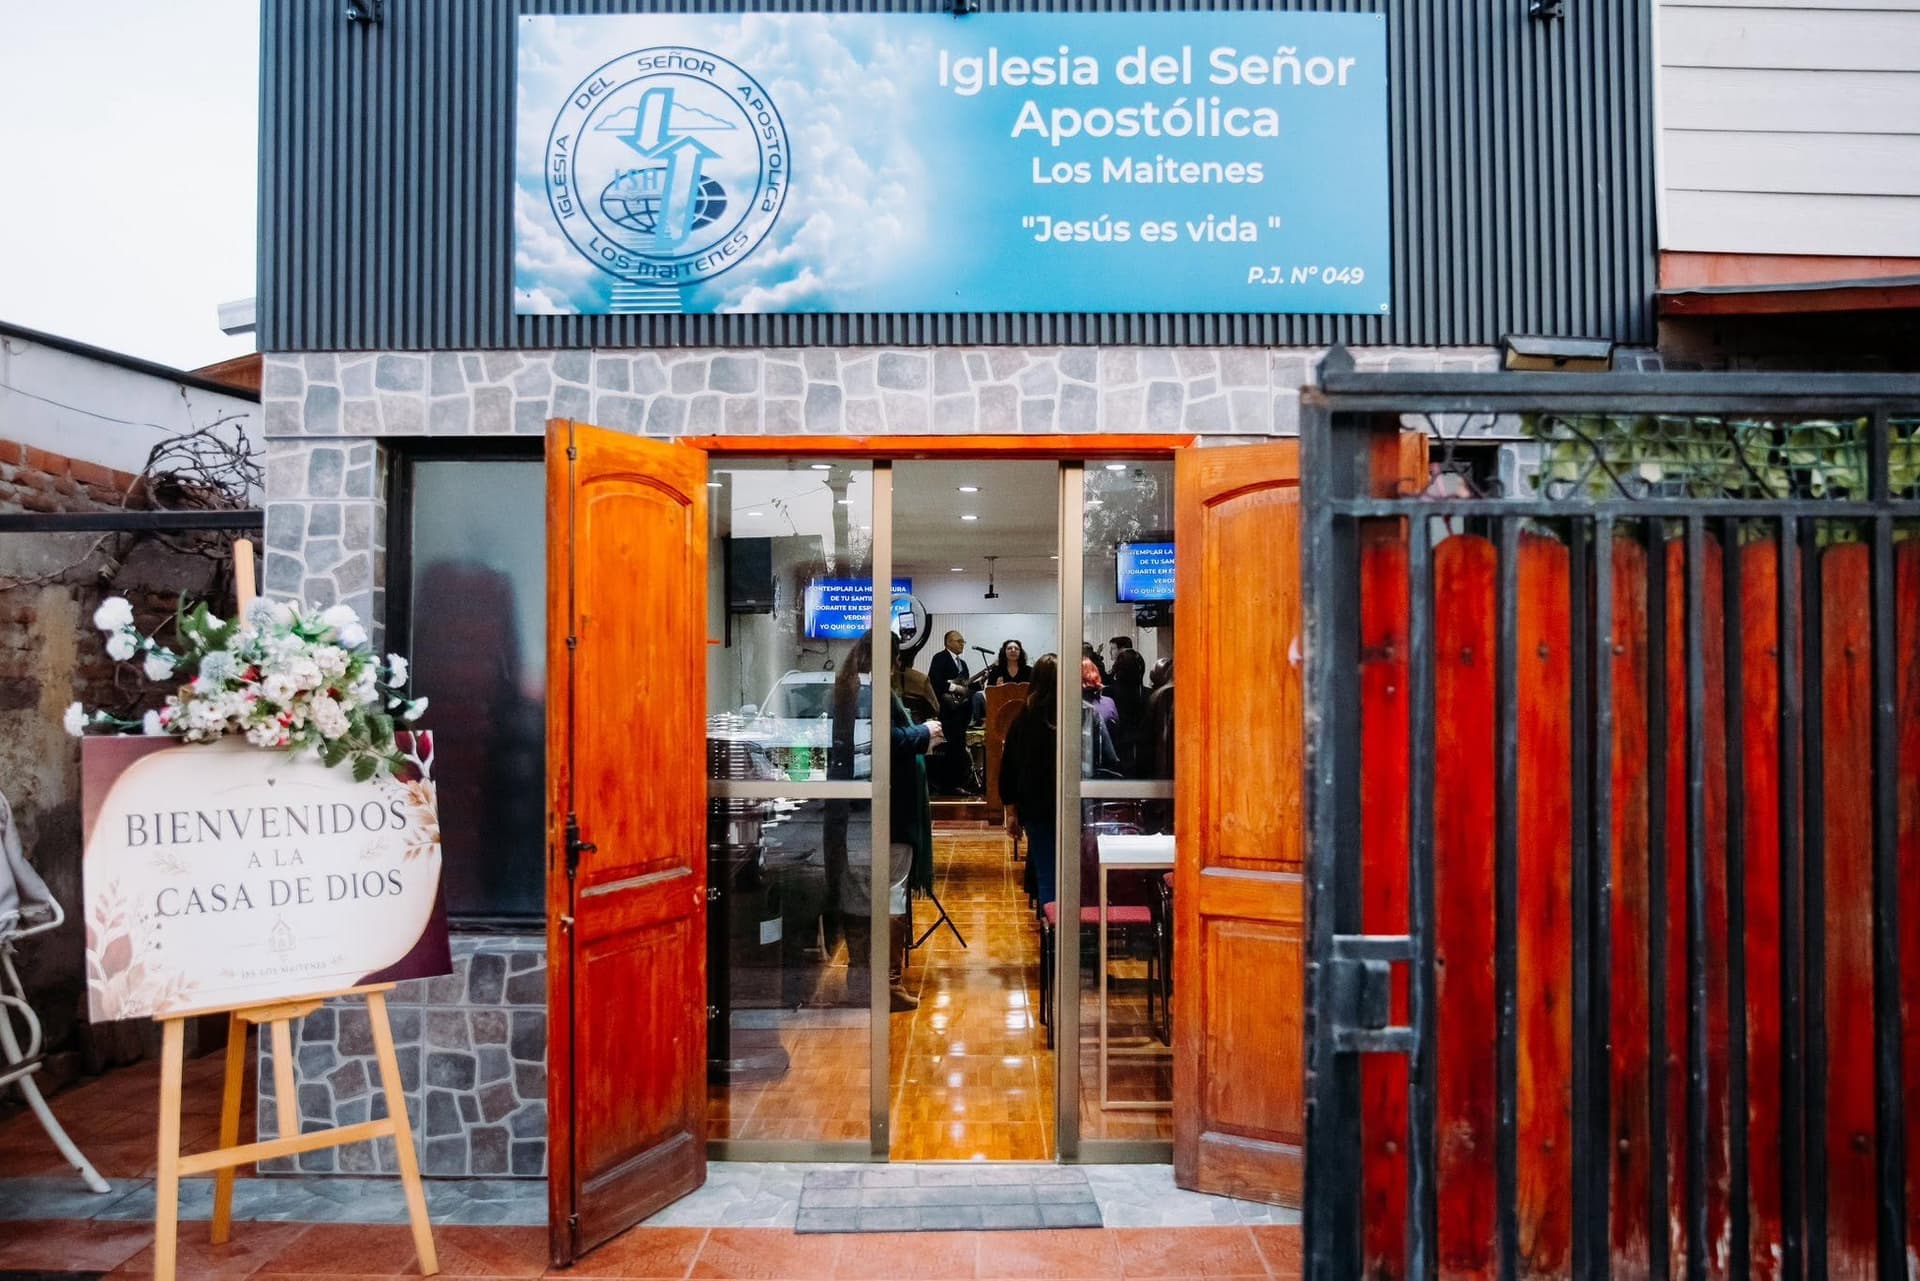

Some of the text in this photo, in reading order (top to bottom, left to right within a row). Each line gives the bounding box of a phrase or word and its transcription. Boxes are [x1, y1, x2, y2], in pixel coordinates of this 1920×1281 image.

[938, 45, 1356, 96] Iglesia del Señor
[553, 134, 575, 219] IGLESIA
[574, 76, 616, 110] DEL
[637, 51, 717, 77] SEÑOR
[1010, 97, 1280, 146] Apostólica
[1032, 156, 1264, 184] Los Maitenes
[1022, 213, 1132, 243] "Jesús
[1139, 219, 1179, 243] es
[1186, 213, 1258, 243] vida
[588, 236, 634, 270] LOS
[1247, 265, 1285, 285] P.J.
[1321, 265, 1366, 285] 049
[125, 800, 408, 848] BIENVENIDOS
[248, 848, 305, 869] A LA
[156, 868, 404, 918] CASA DE DIOS
